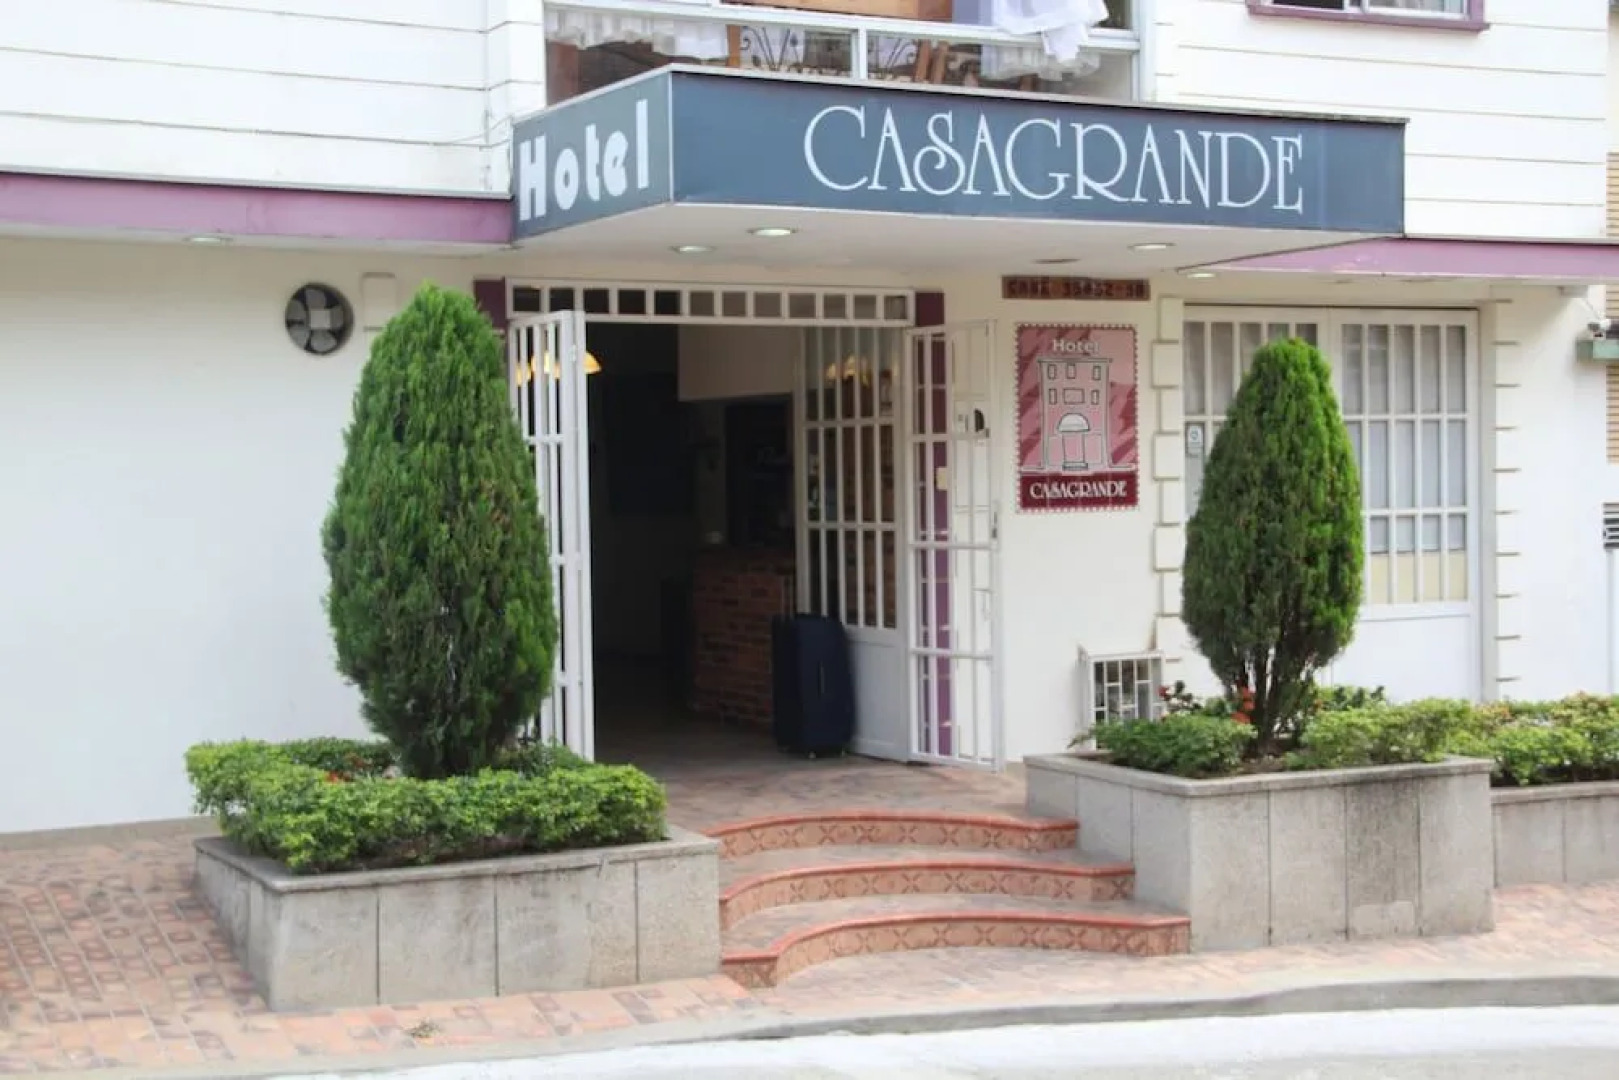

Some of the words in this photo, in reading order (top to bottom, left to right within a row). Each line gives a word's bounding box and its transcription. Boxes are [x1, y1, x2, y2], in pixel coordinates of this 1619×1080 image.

[519, 99, 648, 221] Hotel
[803, 105, 1304, 214] CASAGRANDE
[1052, 339, 1101, 353] Hotel
[1030, 481, 1127, 498] CASAGRANDE
